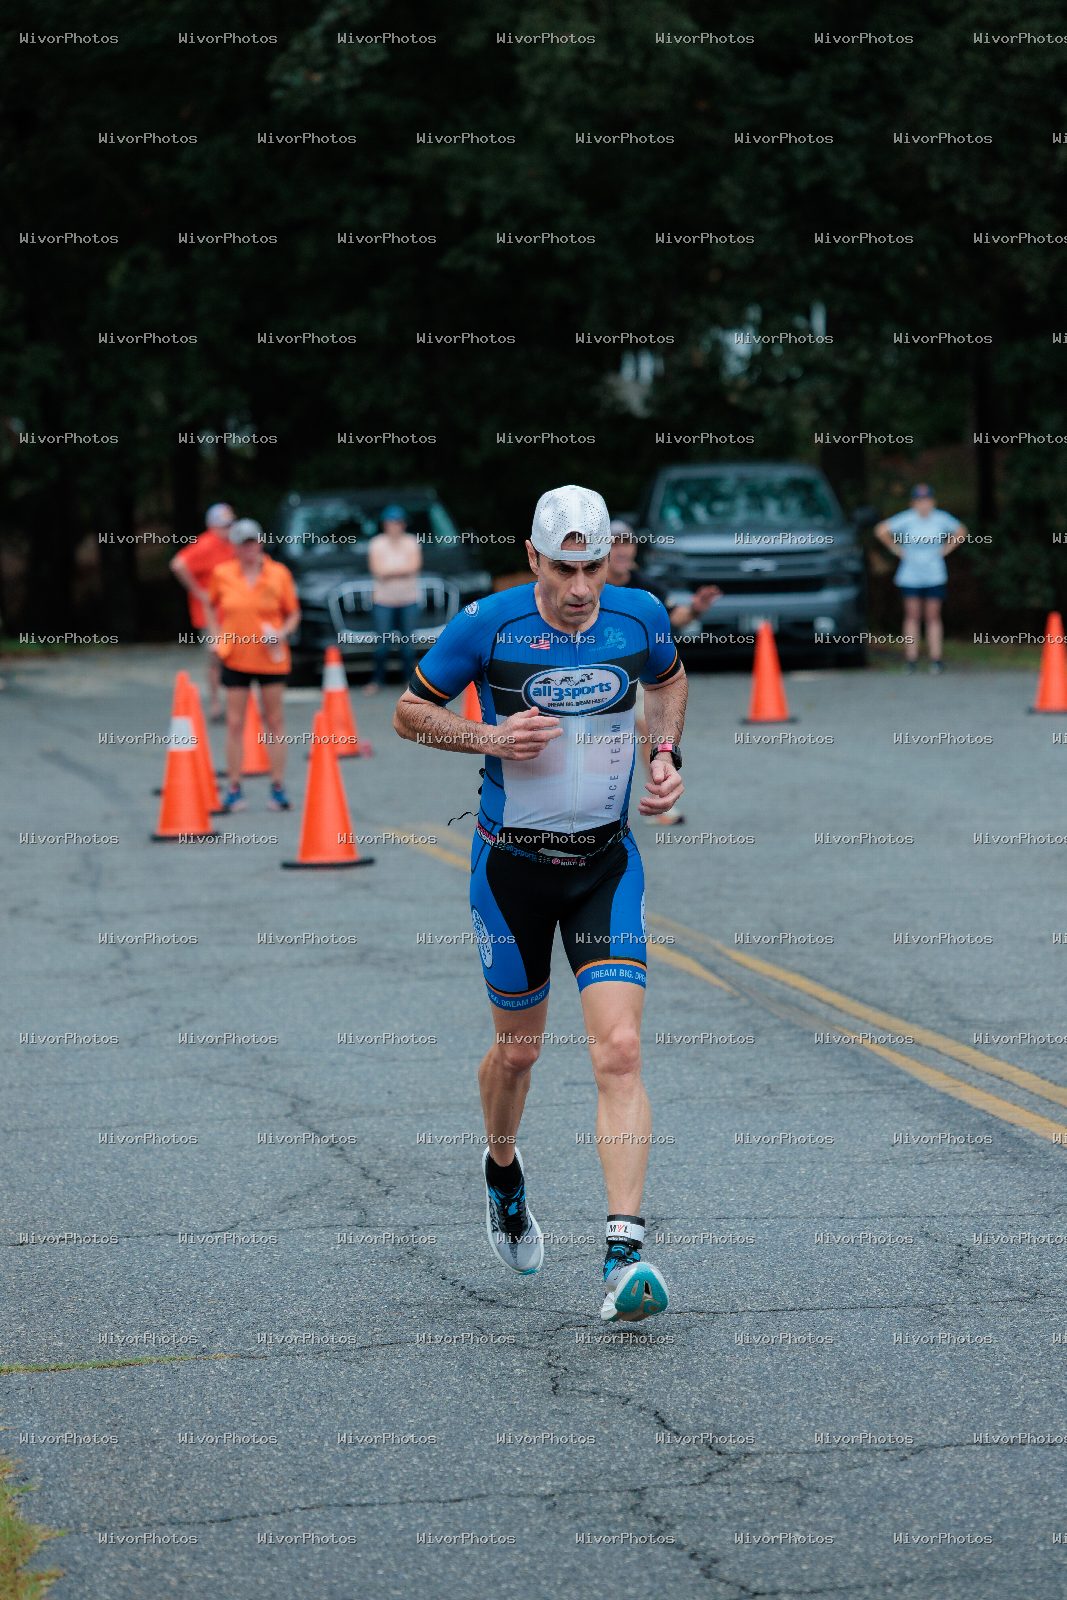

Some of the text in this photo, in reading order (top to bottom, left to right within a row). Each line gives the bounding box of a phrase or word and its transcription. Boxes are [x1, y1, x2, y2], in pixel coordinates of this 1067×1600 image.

[532, 683, 612, 702] all3sports
[605, 776, 619, 810] RACE
[591, 968, 617, 980] DREAM
[619, 969, 634, 979] BIG.
